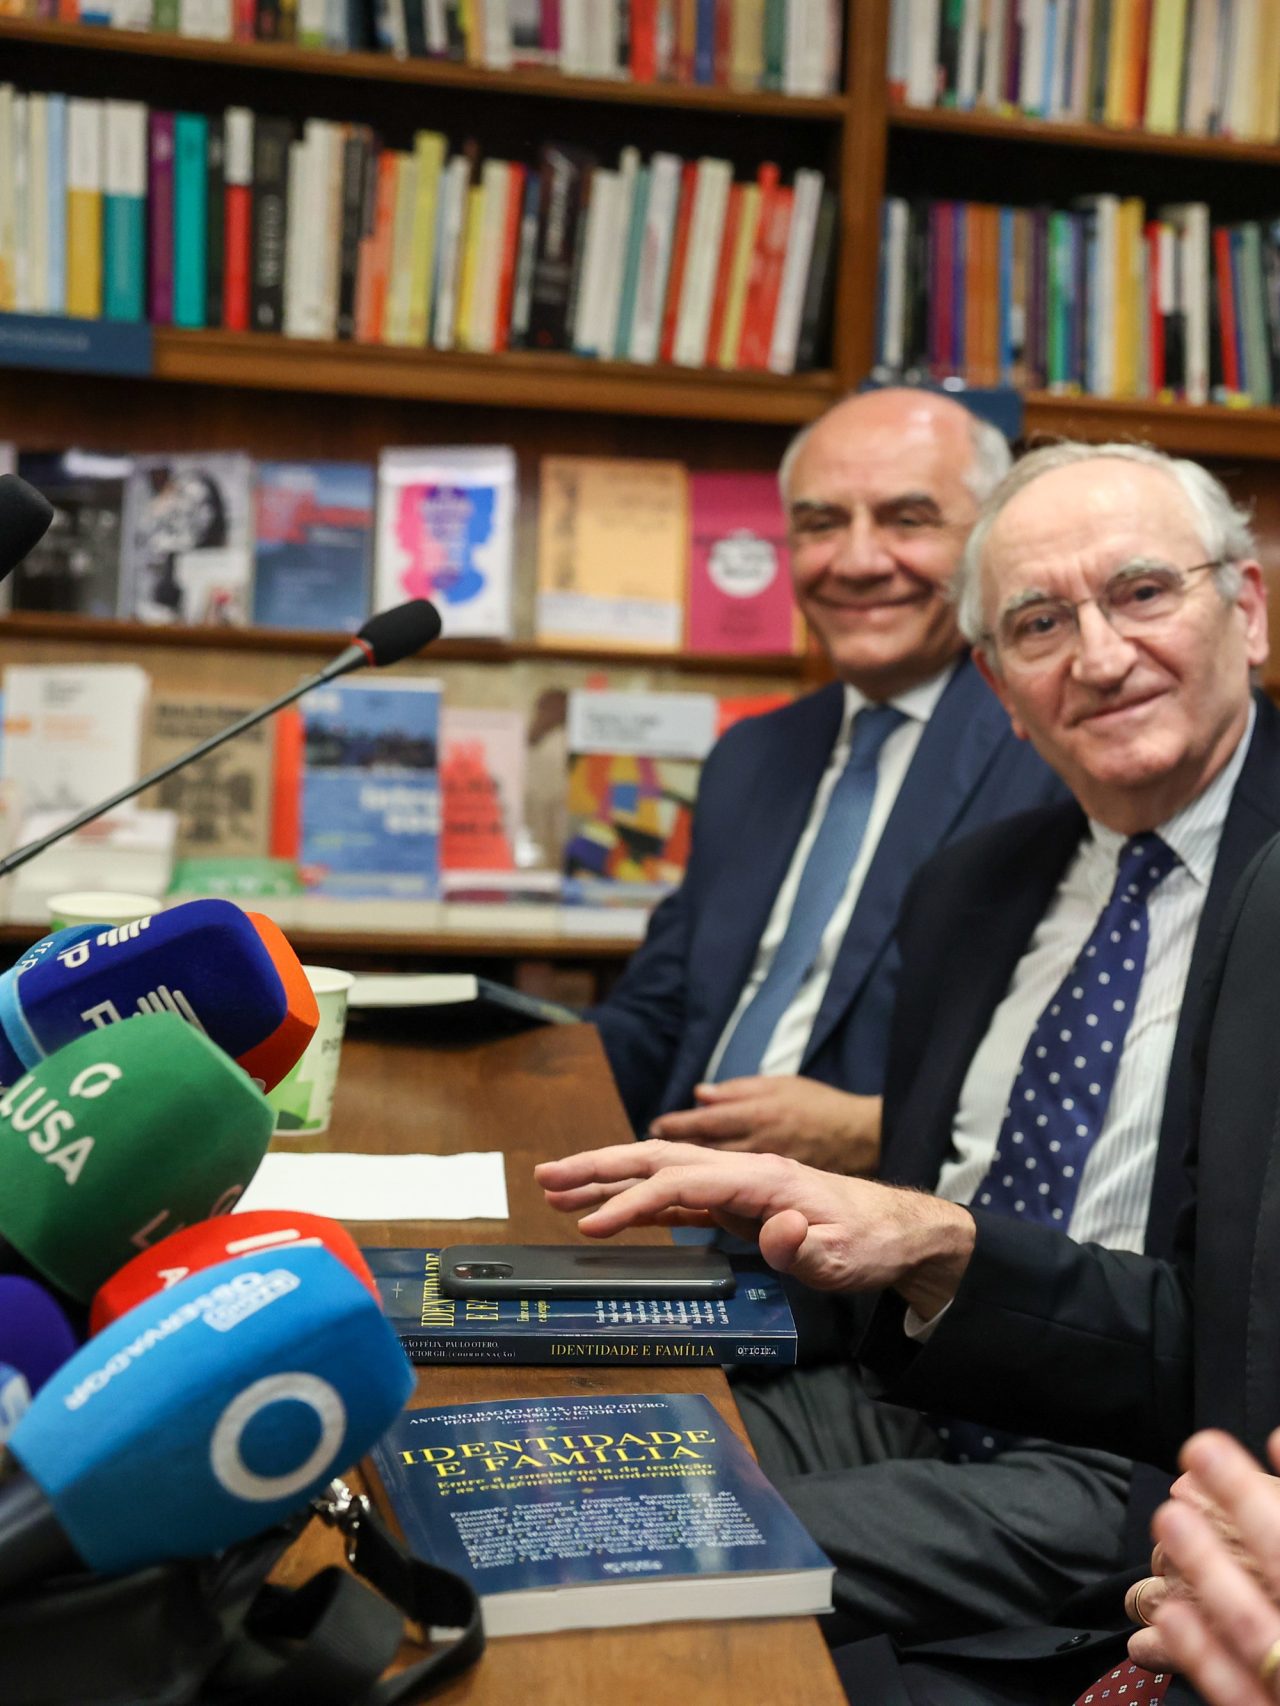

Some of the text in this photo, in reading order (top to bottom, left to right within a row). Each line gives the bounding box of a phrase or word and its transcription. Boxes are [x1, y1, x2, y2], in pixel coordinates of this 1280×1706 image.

[0, 1075, 95, 1186] LUSA
[551, 1342, 715, 1356] IDENTIDADE E FAMÍLIA
[409, 1413, 473, 1425] ANTÓNIO
[476, 1408, 523, 1417] BAGÃO
[572, 1403, 617, 1411] PAULO
[444, 1416, 491, 1426] PEDRO
[495, 1412, 550, 1421] AFONSO
[563, 1408, 615, 1417] VICTOR
[398, 1429, 716, 1465] IDENTIDADE
[430, 1445, 705, 1478] E FAMÍLIA
[437, 1478, 485, 1489] Entre
[618, 1465, 640, 1473] da
